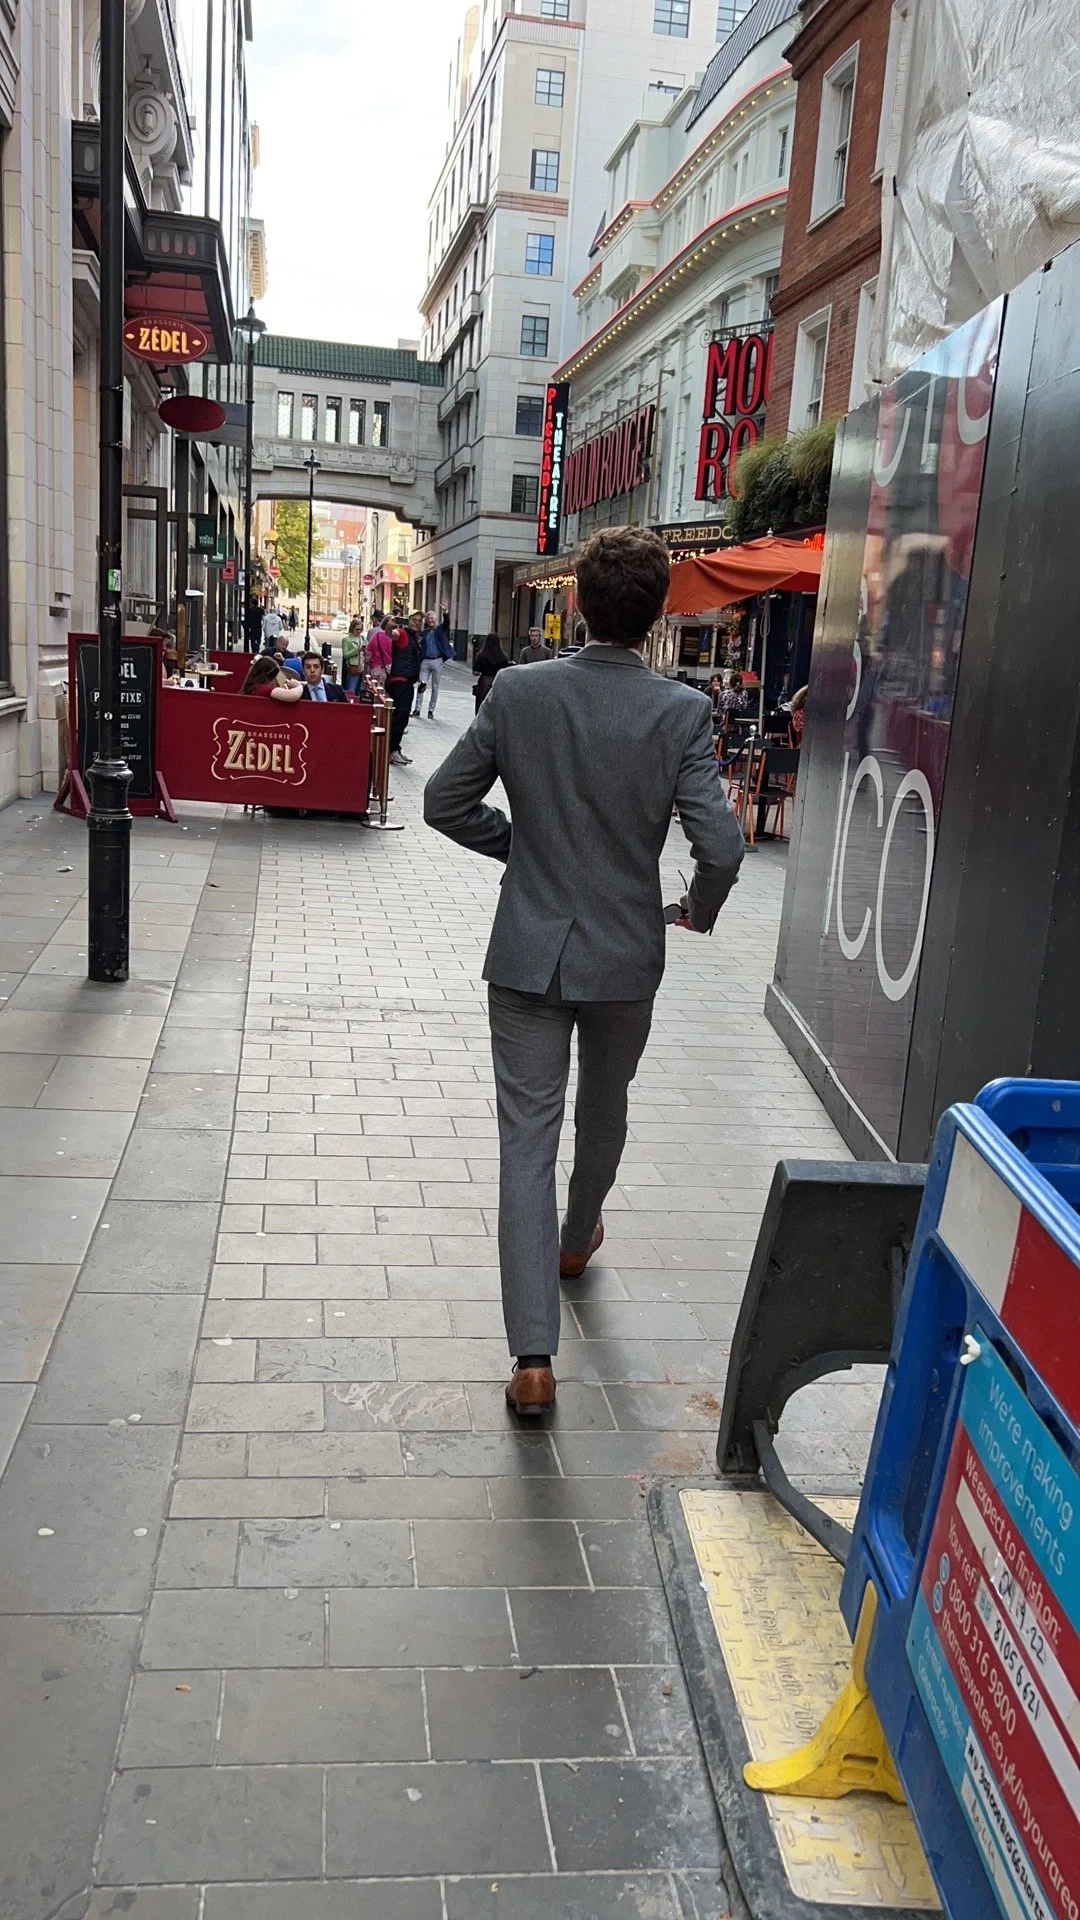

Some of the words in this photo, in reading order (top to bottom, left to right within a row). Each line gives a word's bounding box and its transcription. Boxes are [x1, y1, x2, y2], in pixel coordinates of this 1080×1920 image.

[138, 326, 190, 355] ZÉDEL
[703, 332, 774, 418] MO
[538, 387, 557, 553] PICCADILLY
[549, 411, 564, 529] THEATRE
[561, 435, 601, 517] MOULIN
[661, 525, 734, 543] FREEDO
[120, 692, 142, 703] FIXE
[247, 731, 291, 740] BRASSERIE
[223, 729, 295, 774] ZÉDEL
[978, 1412, 1065, 1575] improvements
[990, 1376, 1022, 1444] We're
[1021, 1438, 1073, 1531] making
[948, 1515, 964, 1557] Your
[961, 1557, 977, 1593] ref:
[965, 1449, 979, 1488] We
[976, 1482, 1006, 1540] expect
[1004, 1526, 1017, 1561] to
[1016, 1550, 1044, 1612] finish
[1042, 1607, 1062, 1644] on:
[949, 1579, 971, 1635] 0800
[969, 1626, 990, 1677] 316
[988, 1669, 1016, 1736] 9800
